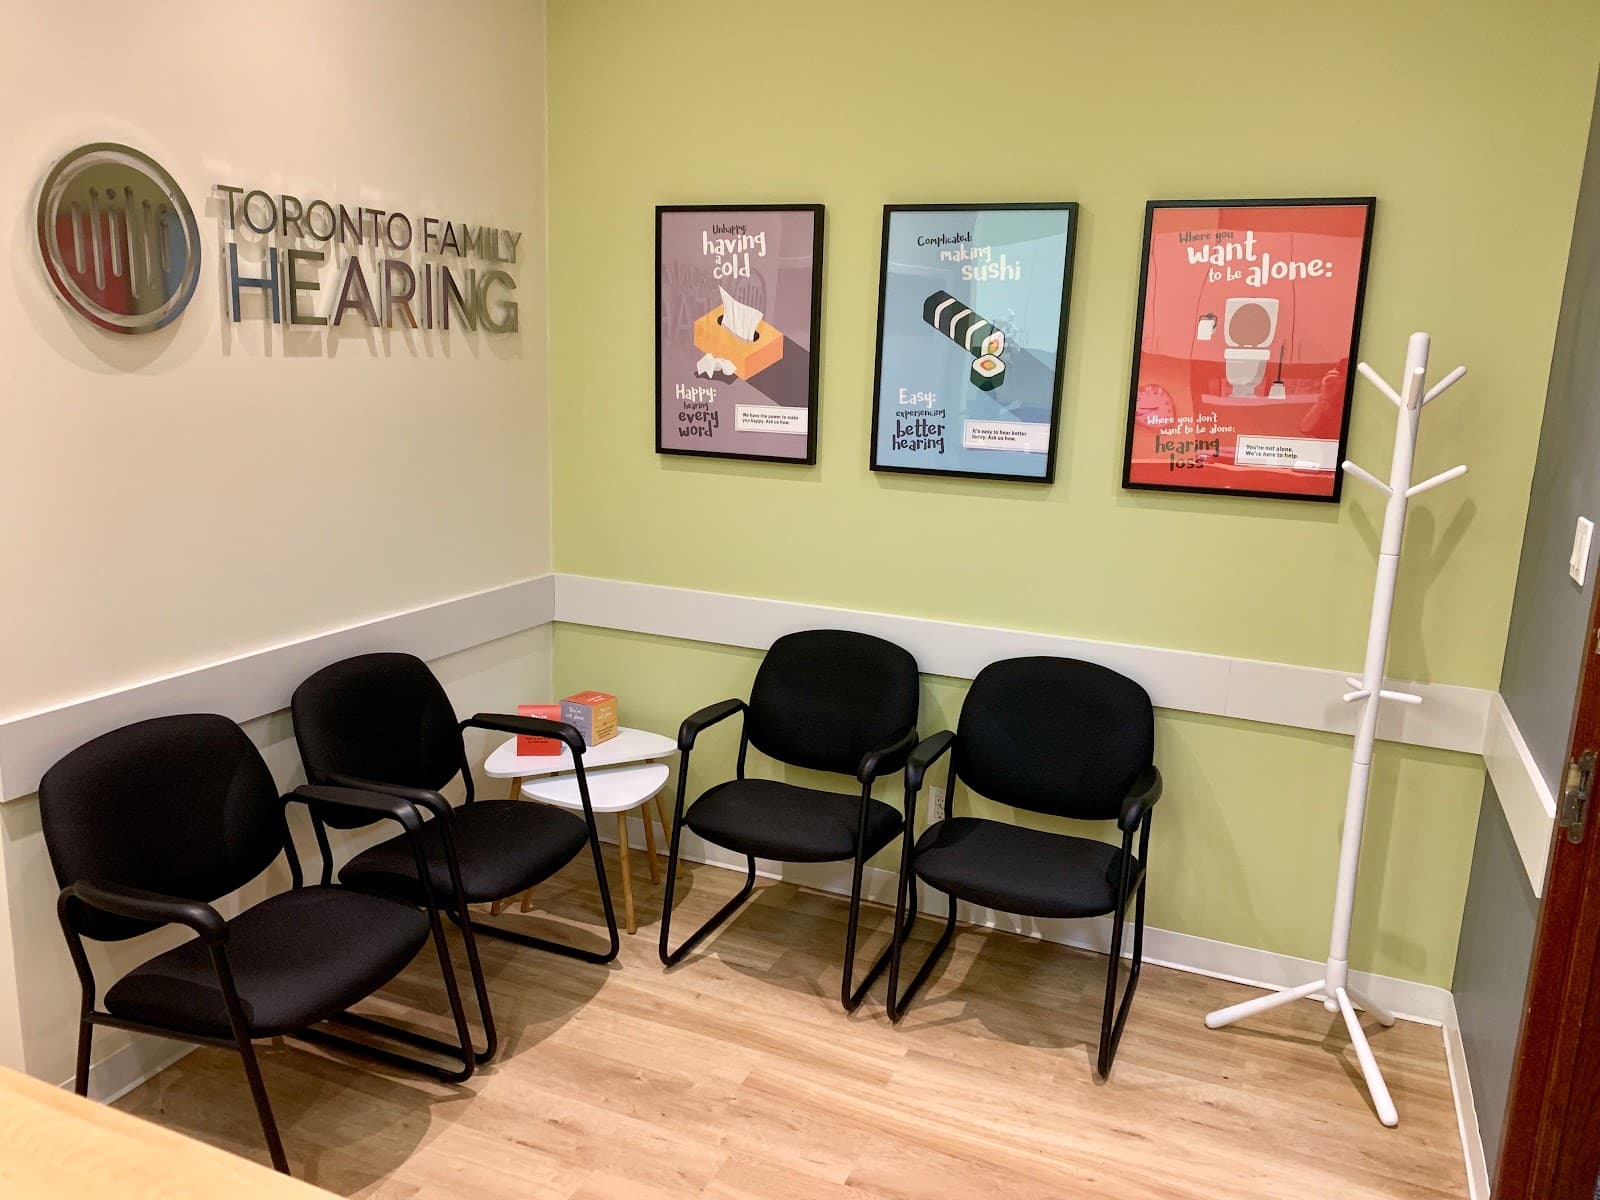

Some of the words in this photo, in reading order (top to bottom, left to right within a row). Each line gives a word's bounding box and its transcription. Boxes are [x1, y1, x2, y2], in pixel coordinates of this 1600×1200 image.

[217, 184, 413, 251] TORONTO
[421, 217, 523, 264] FAMILY
[712, 223, 748, 235] Unhappy:
[702, 230, 767, 257] having
[917, 231, 972, 247] Complicated:
[1178, 232, 1212, 243] Where
[1216, 231, 1234, 244] you
[940, 243, 991, 263] making
[1186, 230, 1257, 266] want
[712, 252, 751, 280] cold
[715, 255, 722, 265] a
[961, 253, 1021, 281] sushi
[1208, 267, 1222, 282] to
[1226, 266, 1242, 281] be
[1245, 253, 1333, 287] alone:
[228, 242, 519, 333] HEARING
[675, 383, 717, 403] Happy:
[899, 387, 937, 409] Easy:
[683, 400, 709, 411] hearing
[895, 408, 946, 420] experiencing
[678, 410, 719, 429] every
[896, 418, 946, 439] better
[1146, 415, 1175, 425] Where
[1177, 416, 1193, 427] you
[1195, 410, 1217, 423] don't
[678, 420, 713, 438] word
[1160, 424, 1182, 435] want
[1184, 425, 1194, 434] to
[1195, 424, 1206, 434] be
[1208, 423, 1236, 435] alone:
[892, 434, 945, 454] hearing
[1155, 435, 1220, 457] hearing
[1170, 453, 1205, 472] loss
